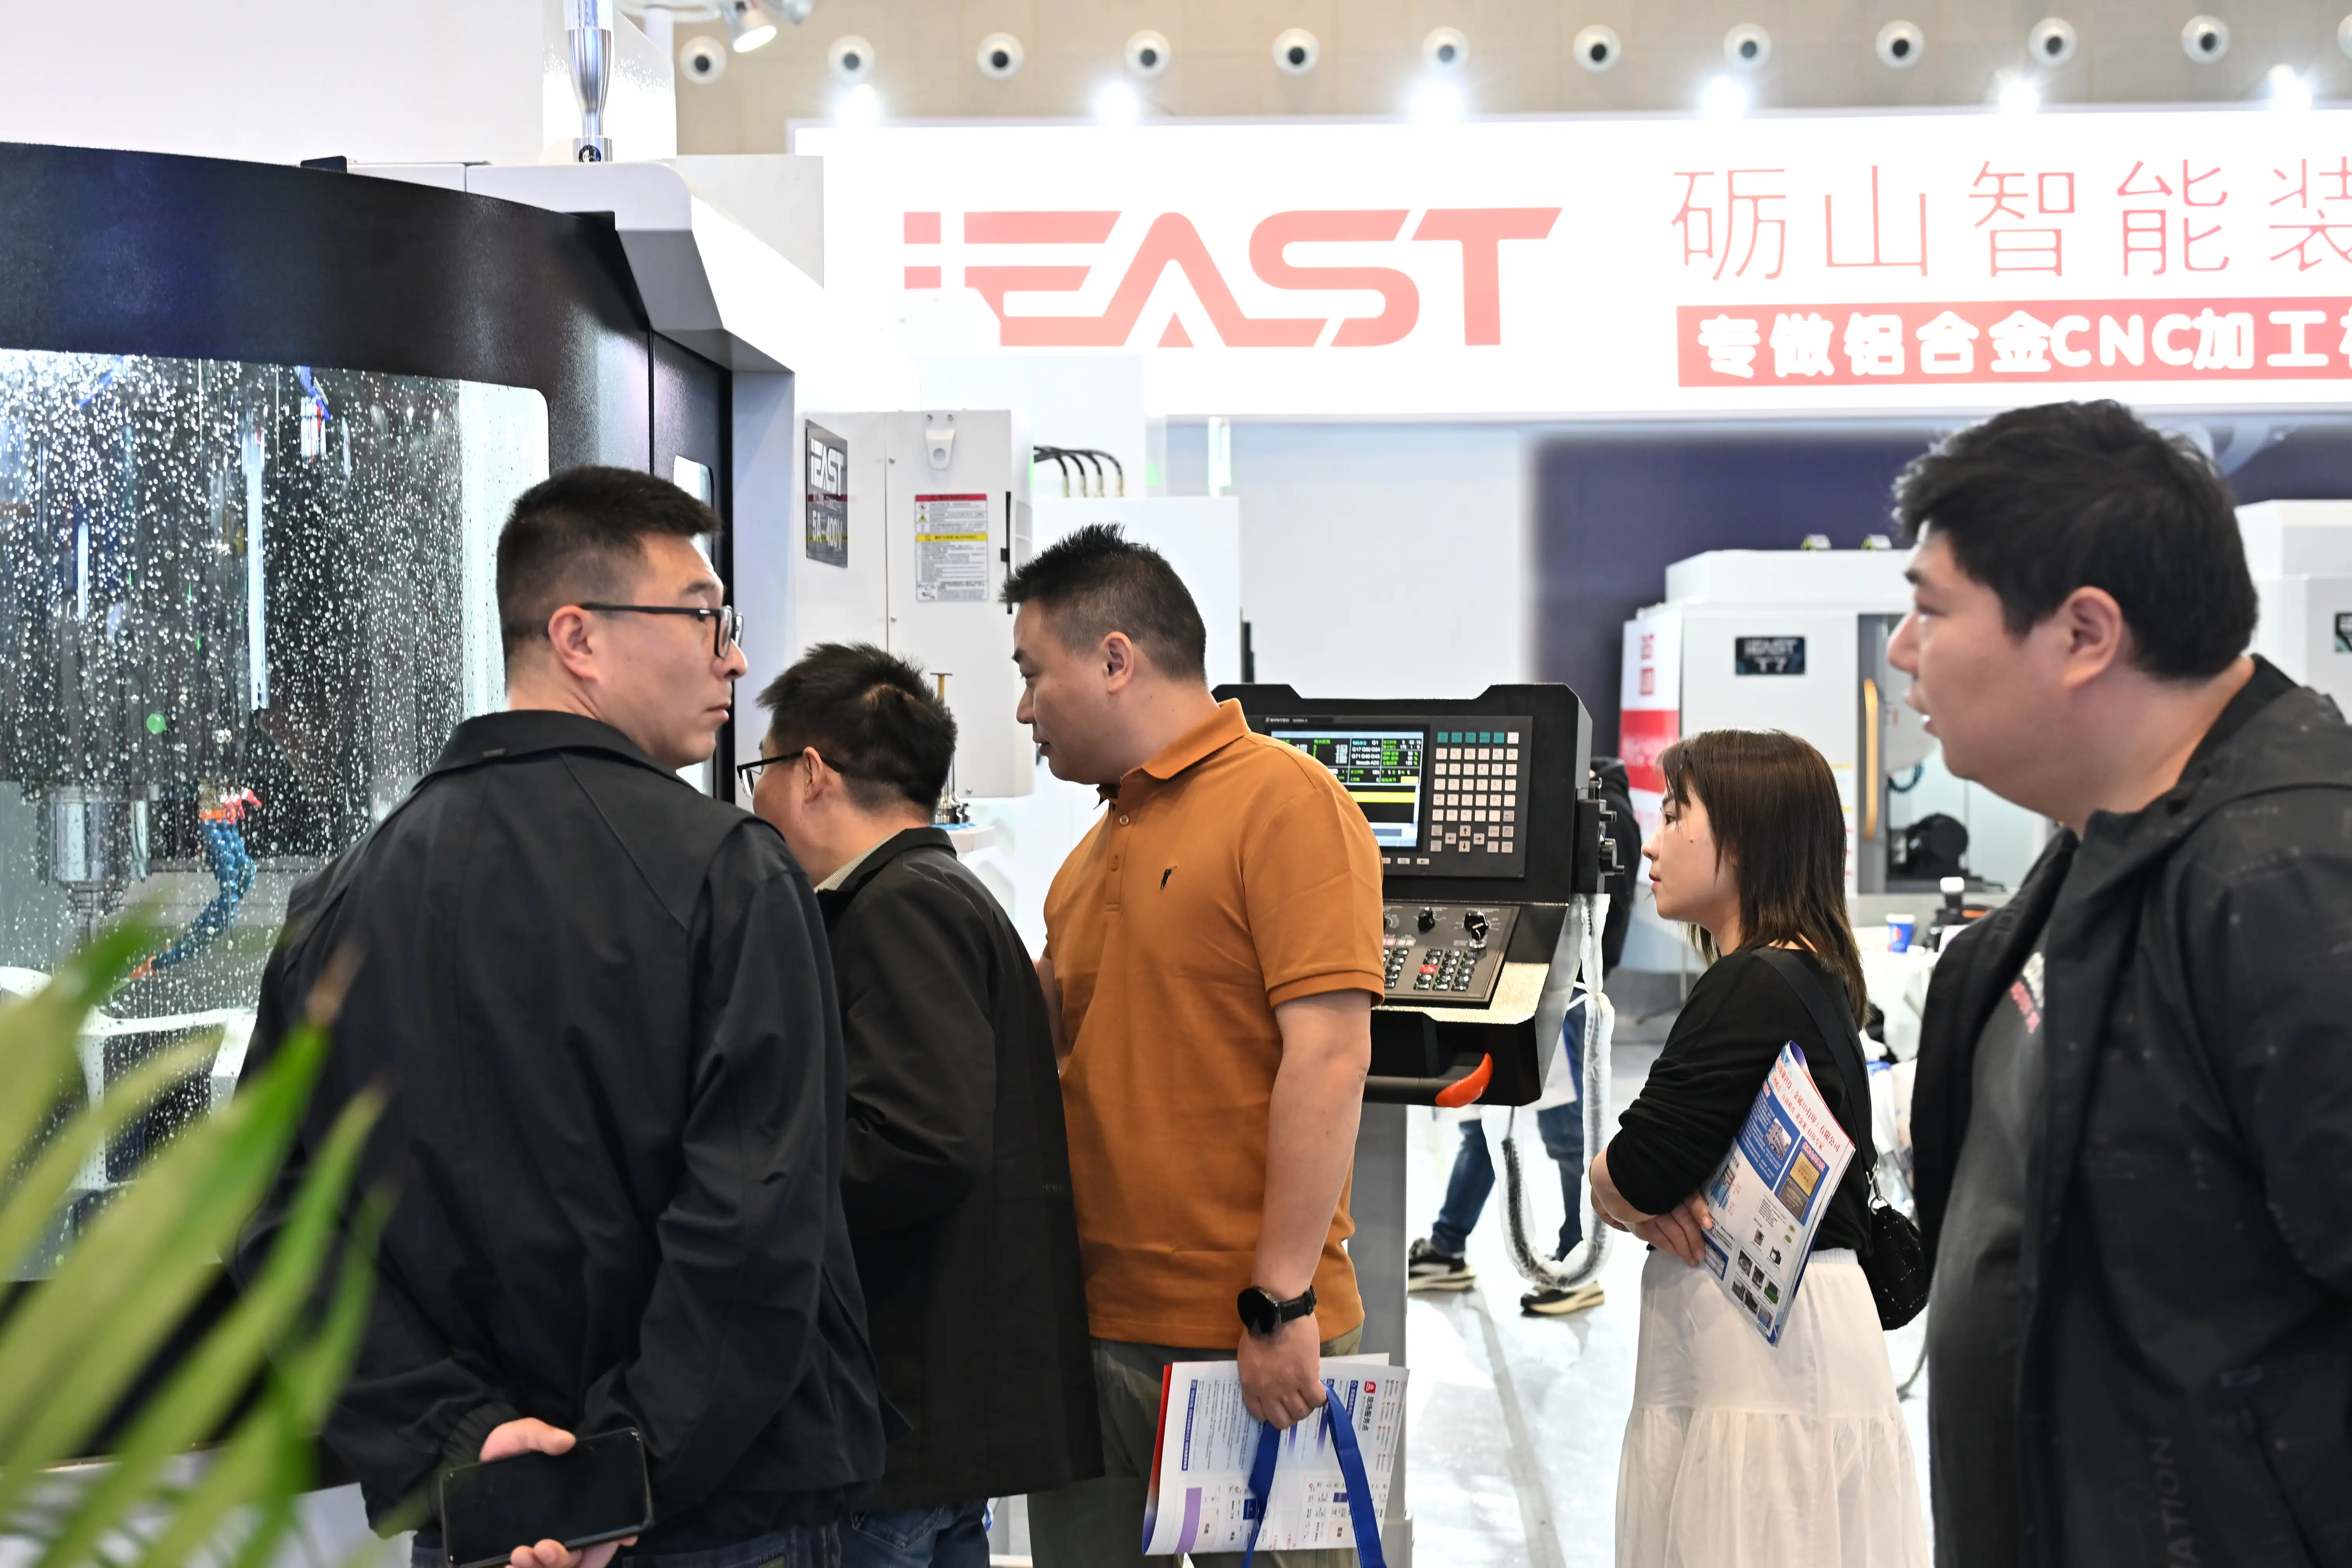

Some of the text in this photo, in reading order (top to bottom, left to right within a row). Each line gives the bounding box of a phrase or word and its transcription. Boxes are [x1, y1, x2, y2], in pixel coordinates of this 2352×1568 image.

[1671, 156, 2352, 282] 砺山智能装
[1697, 305, 2352, 379] 专做铝合金CNC加工
[1362, 1395, 1374, 1431] 现场服务点
[2146, 1437, 2200, 1568] ATION
